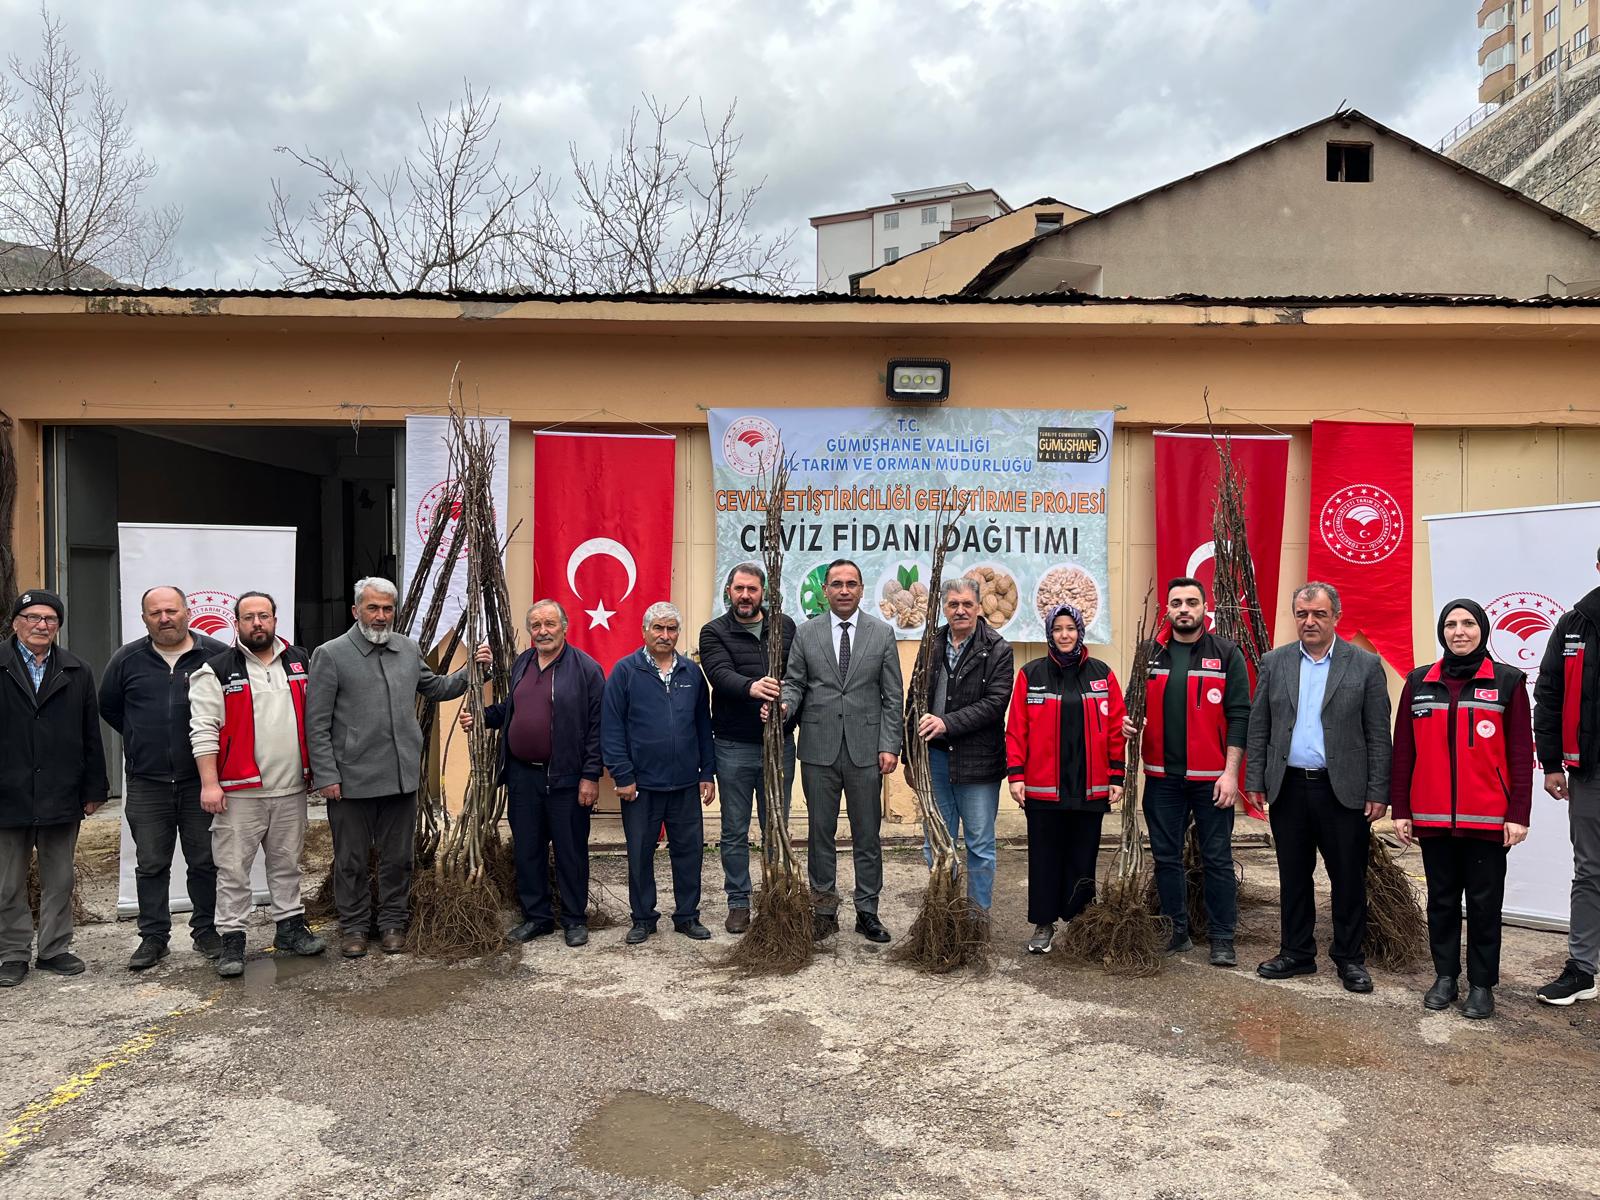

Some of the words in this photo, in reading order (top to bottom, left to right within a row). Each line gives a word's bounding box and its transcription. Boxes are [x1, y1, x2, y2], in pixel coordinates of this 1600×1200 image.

[897, 419, 920, 432] T.C.
[827, 435, 922, 454] GÜMÜŞHANE
[926, 436, 990, 453] VALİLİĞİ
[1039, 438, 1097, 454] GÜMÜŞHANE
[802, 458, 848, 471] TARIM
[853, 458, 872, 470] VE
[877, 457, 930, 471] ORMAN
[936, 455, 1032, 472] MÜDÜRLÜĞÜ
[715, 485, 768, 511] CEVİZ
[770, 484, 911, 515] ETİŞTİRİCİLİĞİ
[915, 485, 1027, 516] GELİŞTİRME
[1031, 488, 1106, 514] PROJESİ
[833, 518, 930, 552] FİDANI
[943, 518, 1079, 554] DAĞITIMI
